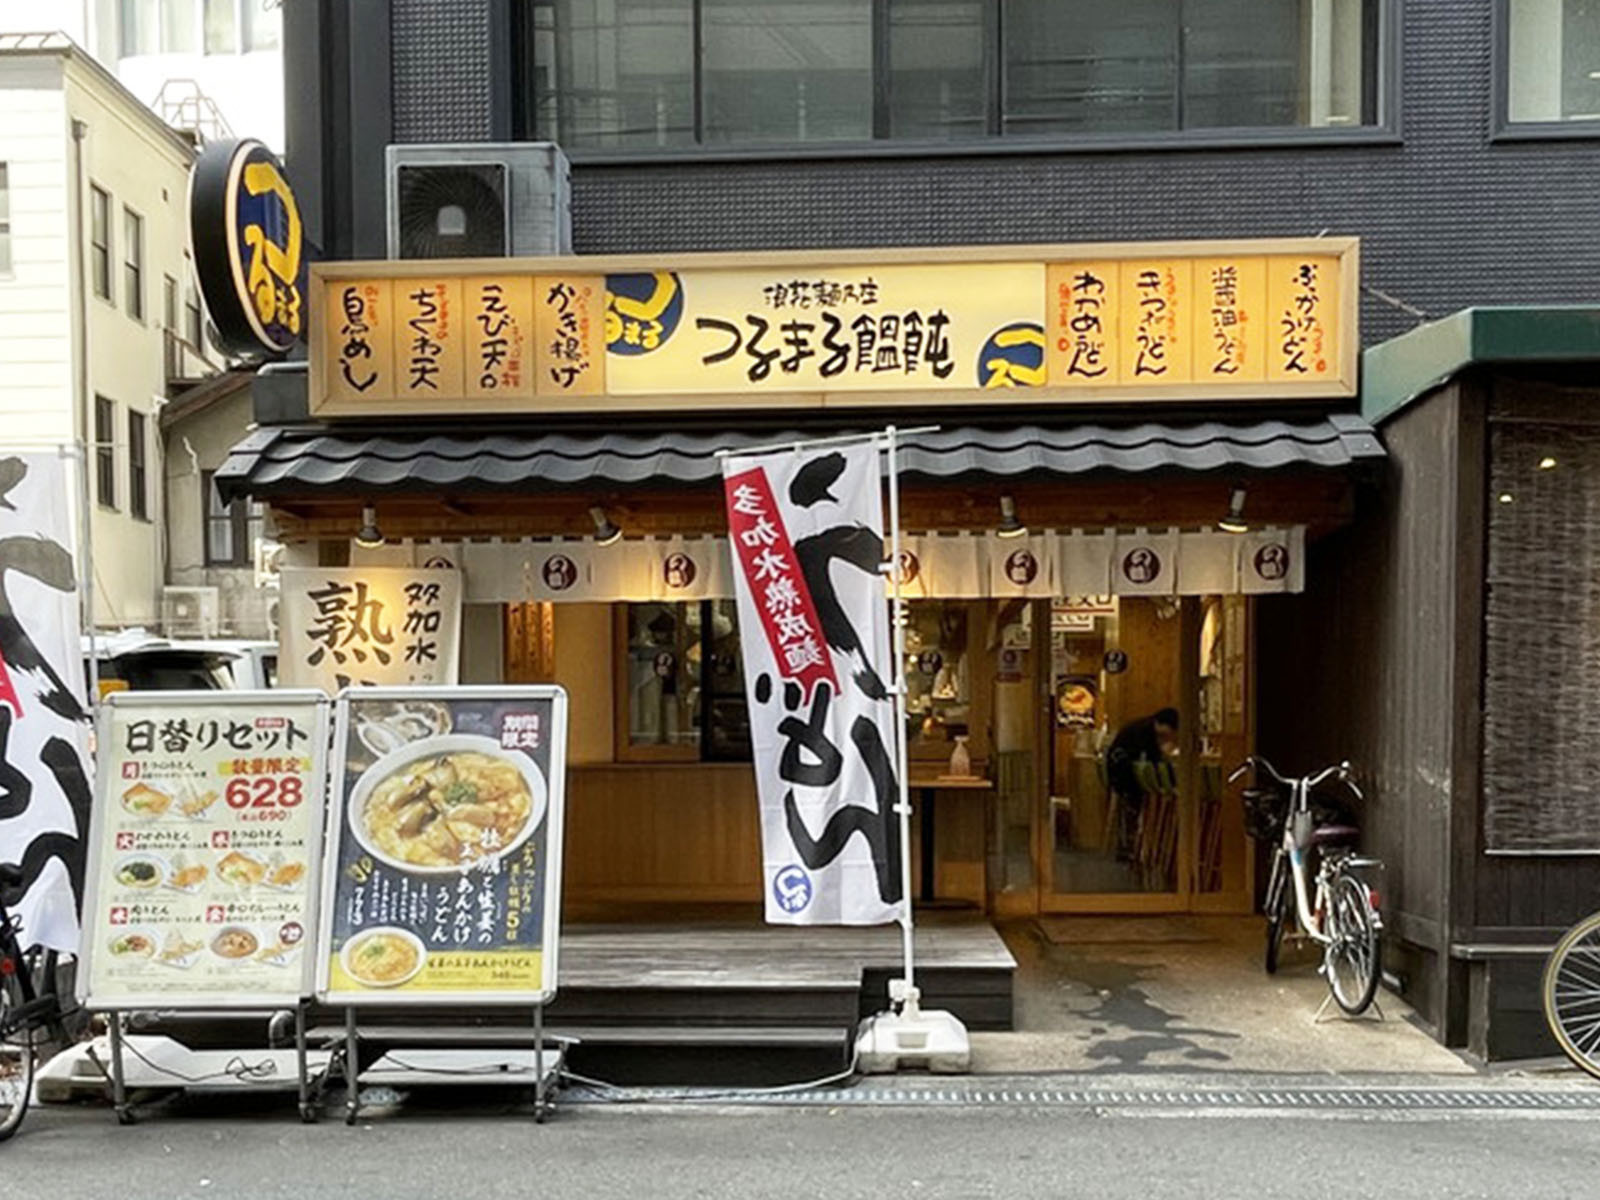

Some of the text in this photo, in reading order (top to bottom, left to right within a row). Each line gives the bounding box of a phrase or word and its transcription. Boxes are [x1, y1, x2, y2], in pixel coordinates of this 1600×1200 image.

[408, 288, 442, 390] ちくわ天
[547, 282, 590, 389] かき揚げ
[696, 309, 955, 383] つるまる饂飩
[1067, 270, 1108, 378] わかめうどん
[1135, 272, 1168, 376] きつねうどん
[307, 581, 394, 687] 熟
[126, 718, 308, 754] 日替りセット
[232, 757, 300, 774] 数量限定
[225, 777, 303, 809] 628
[431, 886, 451, 943] うどん
